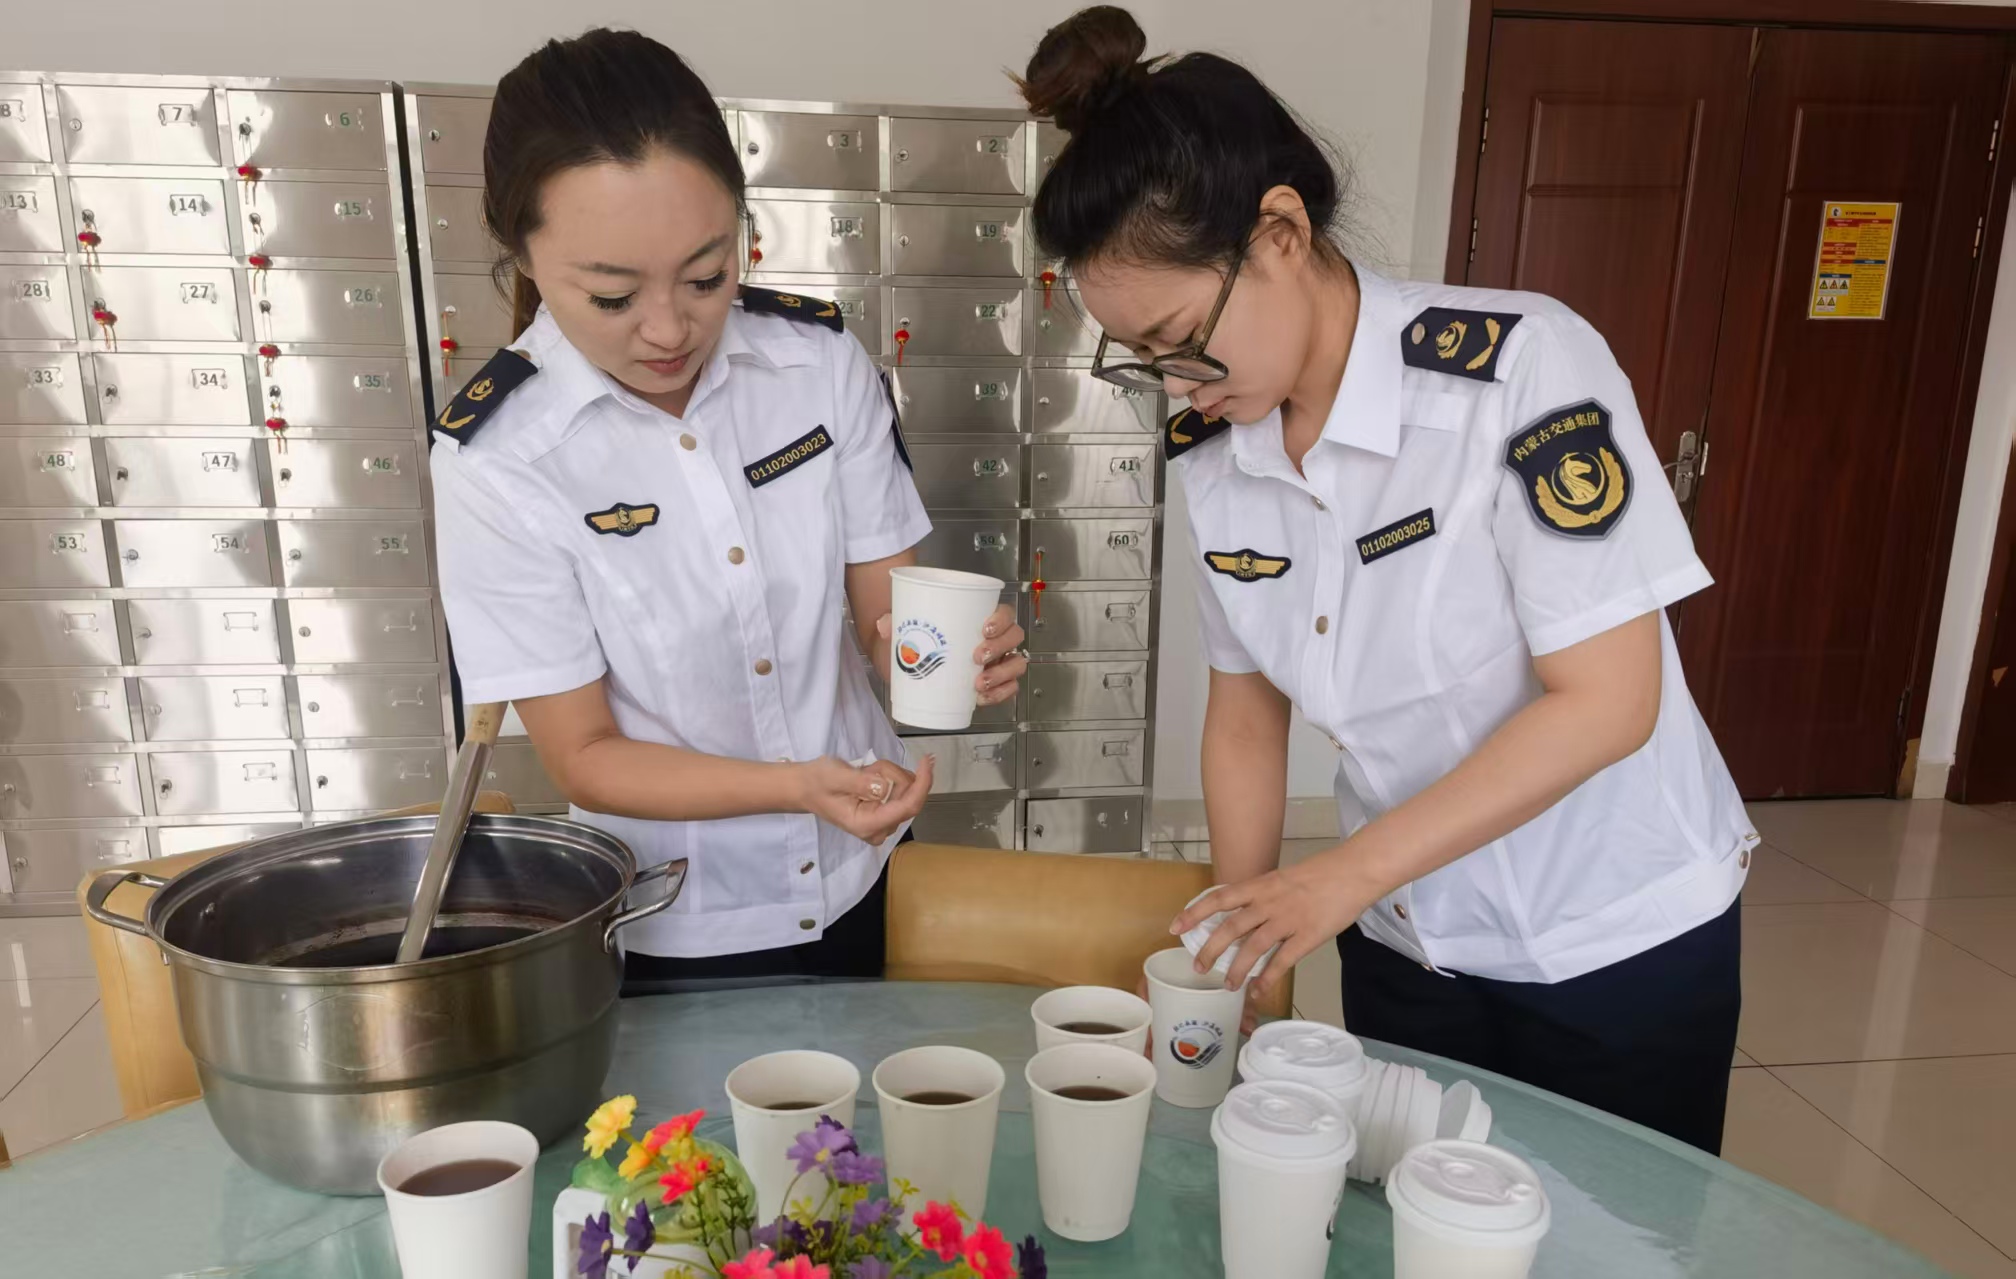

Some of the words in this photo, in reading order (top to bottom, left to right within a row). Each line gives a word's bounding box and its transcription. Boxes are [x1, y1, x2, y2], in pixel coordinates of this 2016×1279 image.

[0, 105, 11, 118] 8
[172, 107, 182, 120] 7
[340, 112, 350, 126] 6
[840, 134, 849, 146] 3
[988, 139, 998, 152] 2
[8, 195, 27, 209] 13
[178, 198, 197, 212] 14
[342, 202, 362, 215] 15
[838, 220, 853, 233] 18
[983, 224, 997, 238] 19
[23, 284, 42, 297] 28
[190, 285, 208, 298] 27
[355, 289, 373, 302] 26
[840, 301, 853, 314] 23
[981, 305, 996, 318] 22
[35, 370, 53, 383] 33
[200, 373, 218, 386] 34
[364, 374, 381, 387] 35
[982, 383, 997, 396] 39
[1121, 387, 1136, 396] 40
[1513, 411, 1600, 462] 内蒙古交通集团
[47, 454, 66, 467] 48
[211, 455, 231, 468] 47
[373, 457, 391, 470] 46
[751, 433, 827, 481] 01102003023
[982, 459, 996, 472] 42
[1119, 459, 1133, 472] 41
[59, 537, 77, 548] 53
[1115, 535, 1129, 545] 60
[1361, 516, 1430, 556] 01102003025
[221, 537, 239, 549] 54
[381, 538, 399, 550] 55
